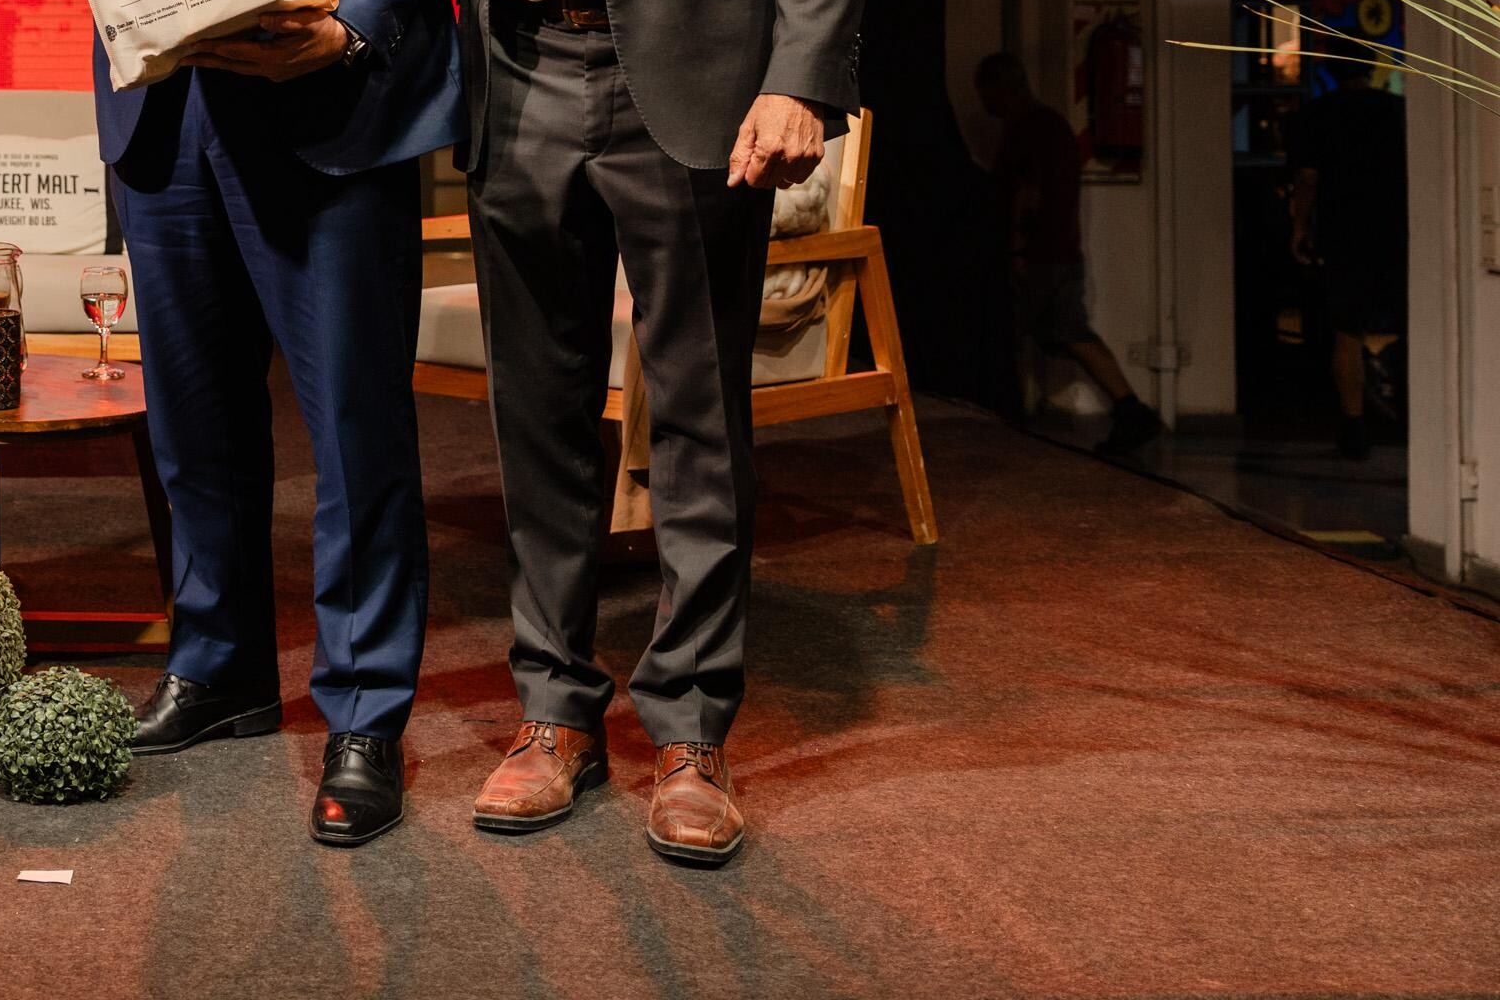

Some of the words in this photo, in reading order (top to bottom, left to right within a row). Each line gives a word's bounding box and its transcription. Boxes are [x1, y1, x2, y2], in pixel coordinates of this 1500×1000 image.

[37, 174, 80, 195] MALT
[30, 198, 53, 210] WIS.
[41, 216, 59, 226] LBS.
